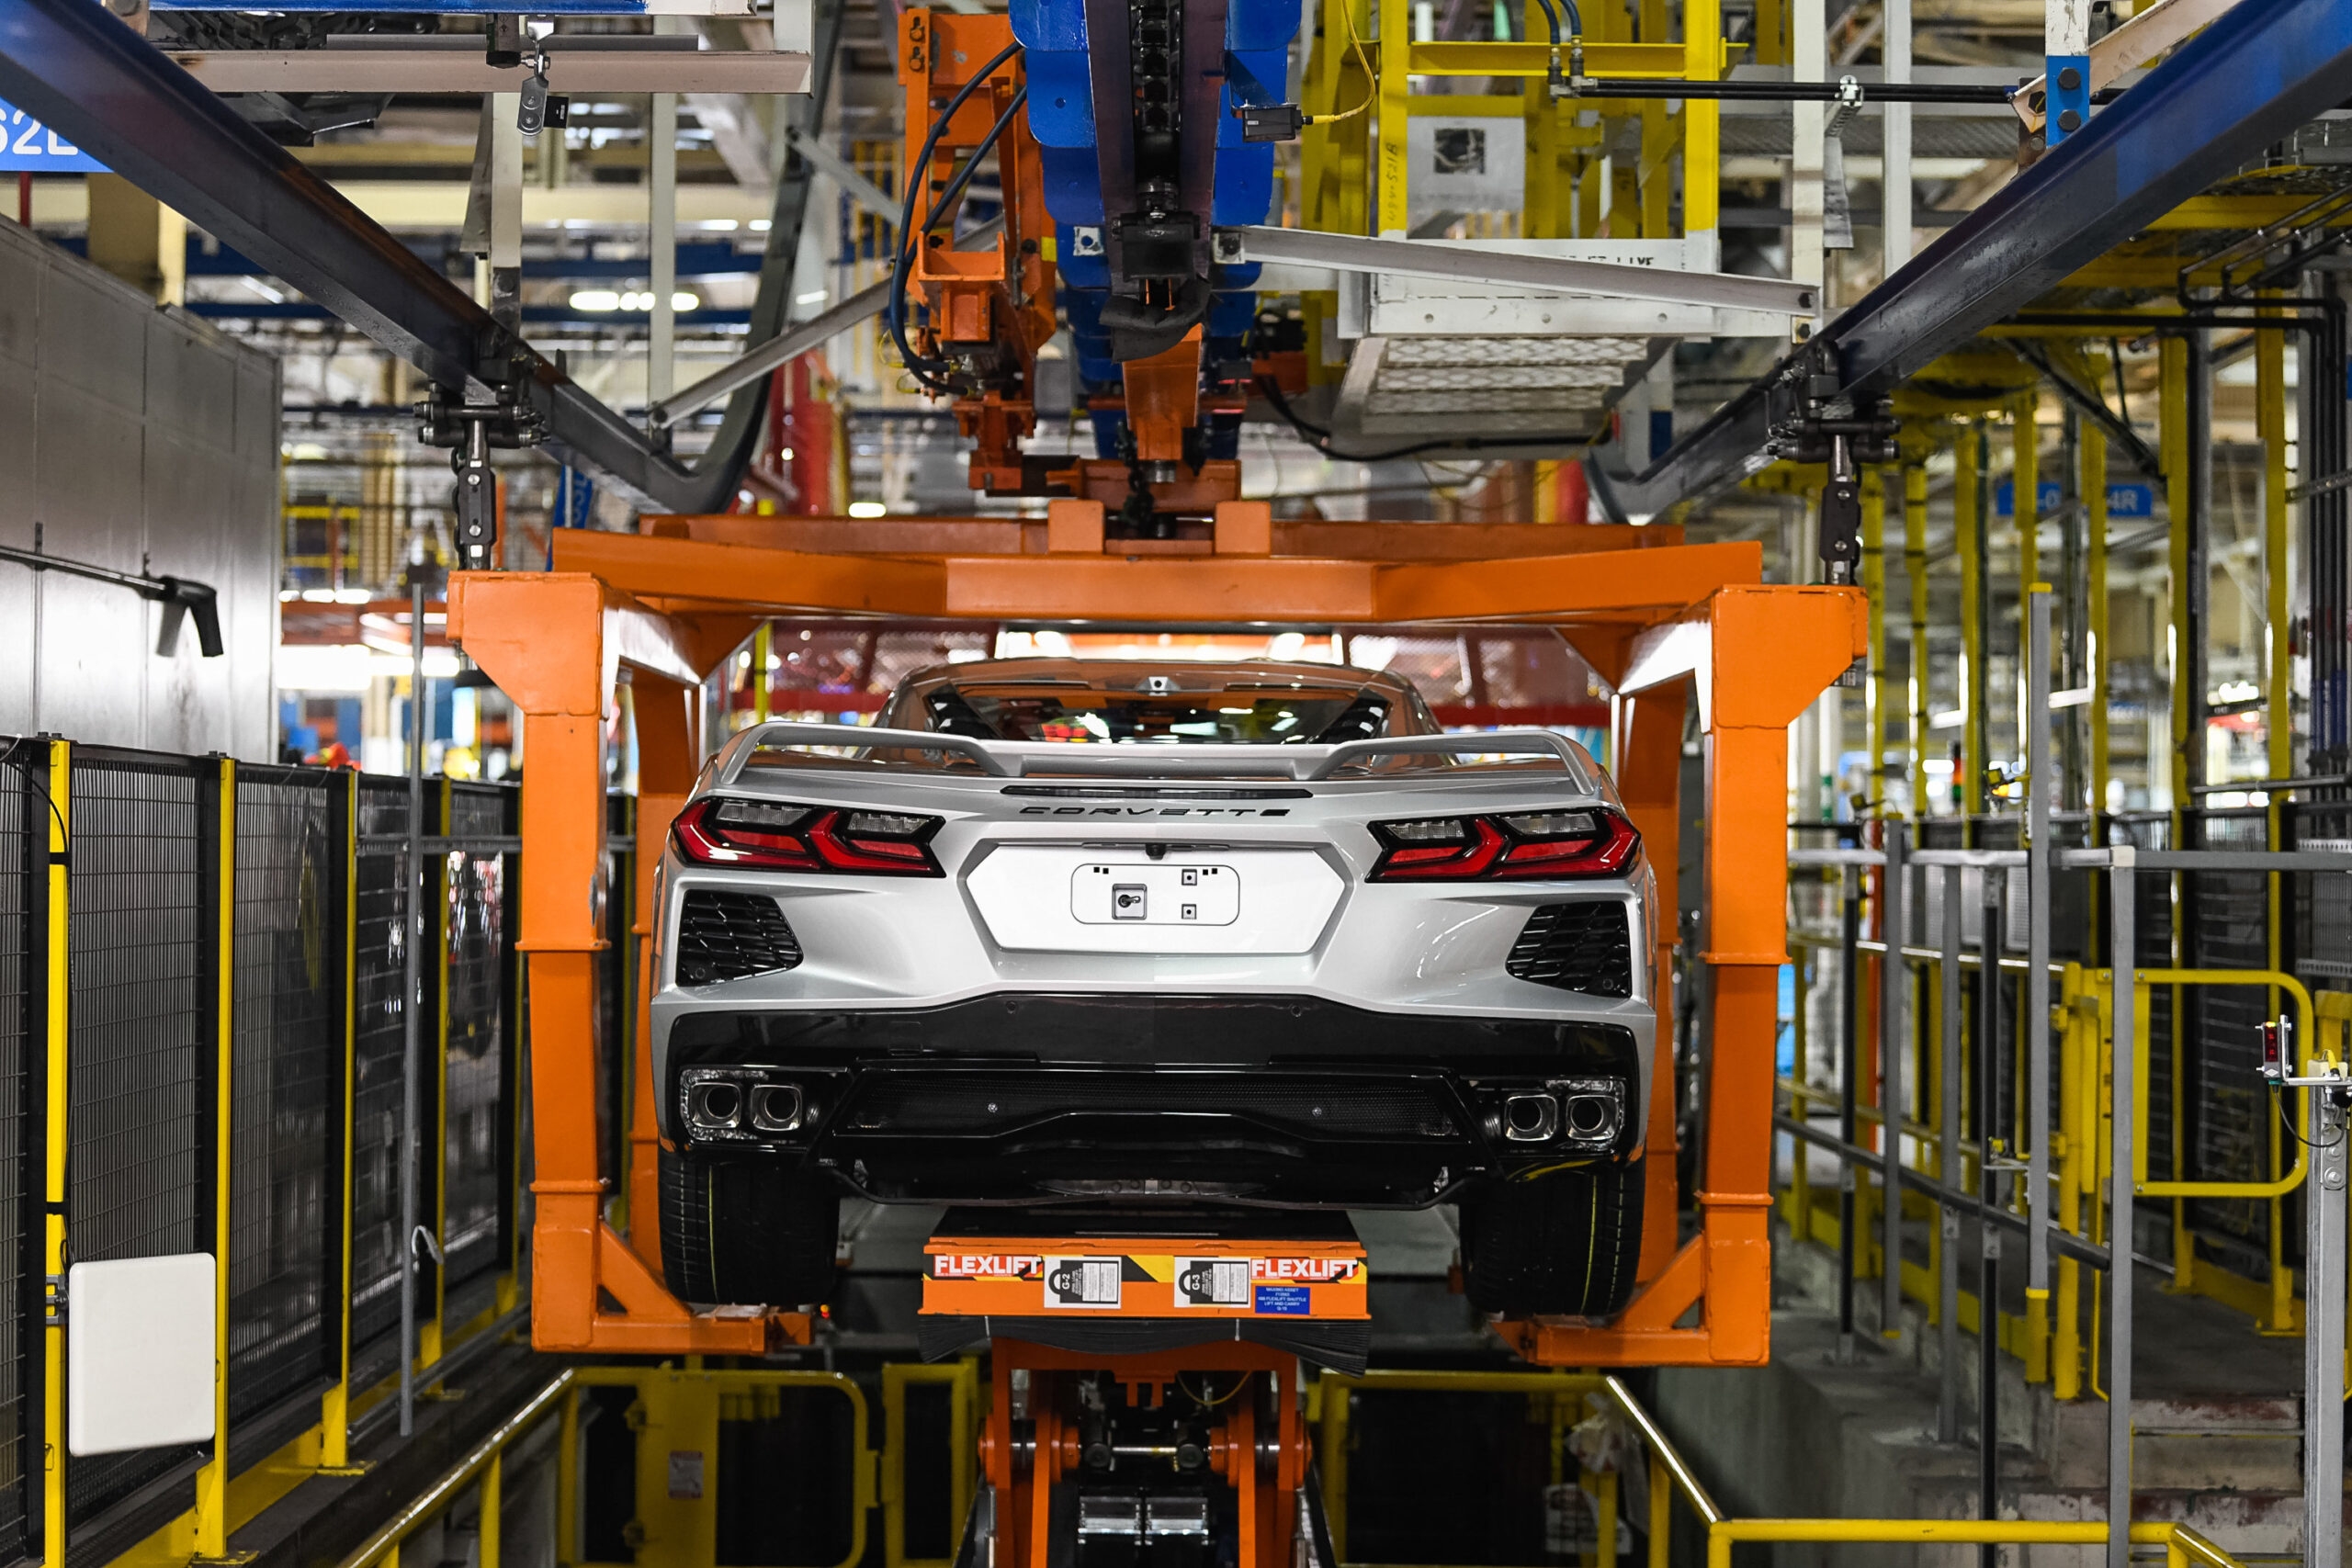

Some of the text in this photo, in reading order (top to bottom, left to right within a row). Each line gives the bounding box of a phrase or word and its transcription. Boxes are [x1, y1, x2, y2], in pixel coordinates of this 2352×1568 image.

[0, 108, 78, 155] 2L
[1019, 807, 1291, 817] CORVETTE
[935, 1255, 1042, 1274] FLEXLIFT
[1251, 1259, 1358, 1277] FLEXLIFT
[1062, 1273, 1070, 1291] G-2
